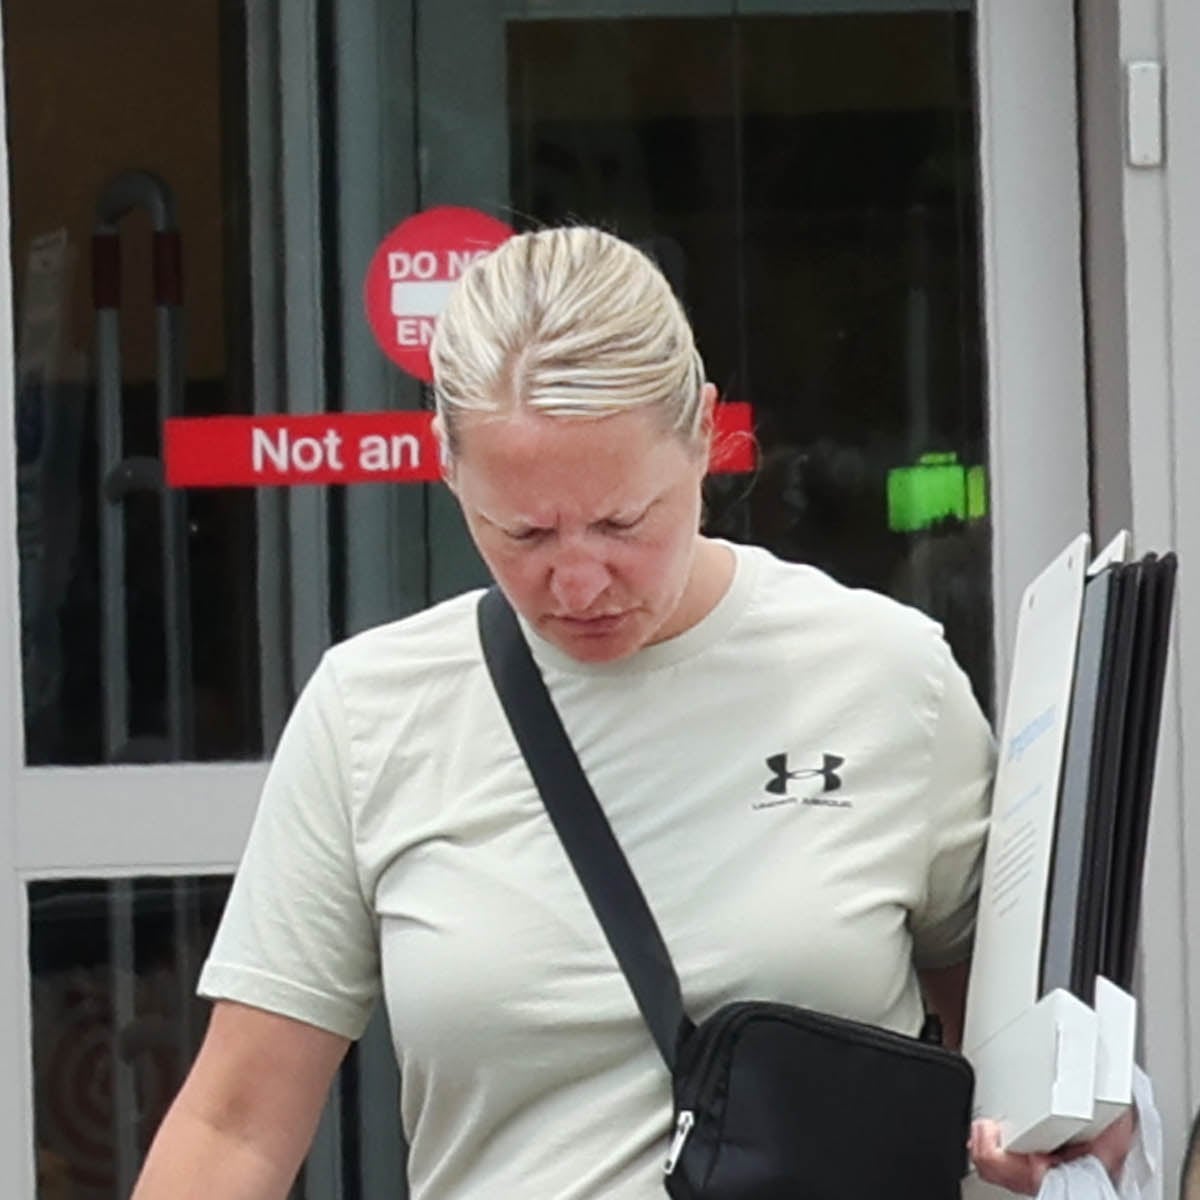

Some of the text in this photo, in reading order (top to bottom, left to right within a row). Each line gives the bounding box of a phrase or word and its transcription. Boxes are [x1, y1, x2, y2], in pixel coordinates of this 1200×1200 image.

[388, 251, 437, 279] DO
[252, 427, 344, 472] Not
[358, 433, 420, 471] an
